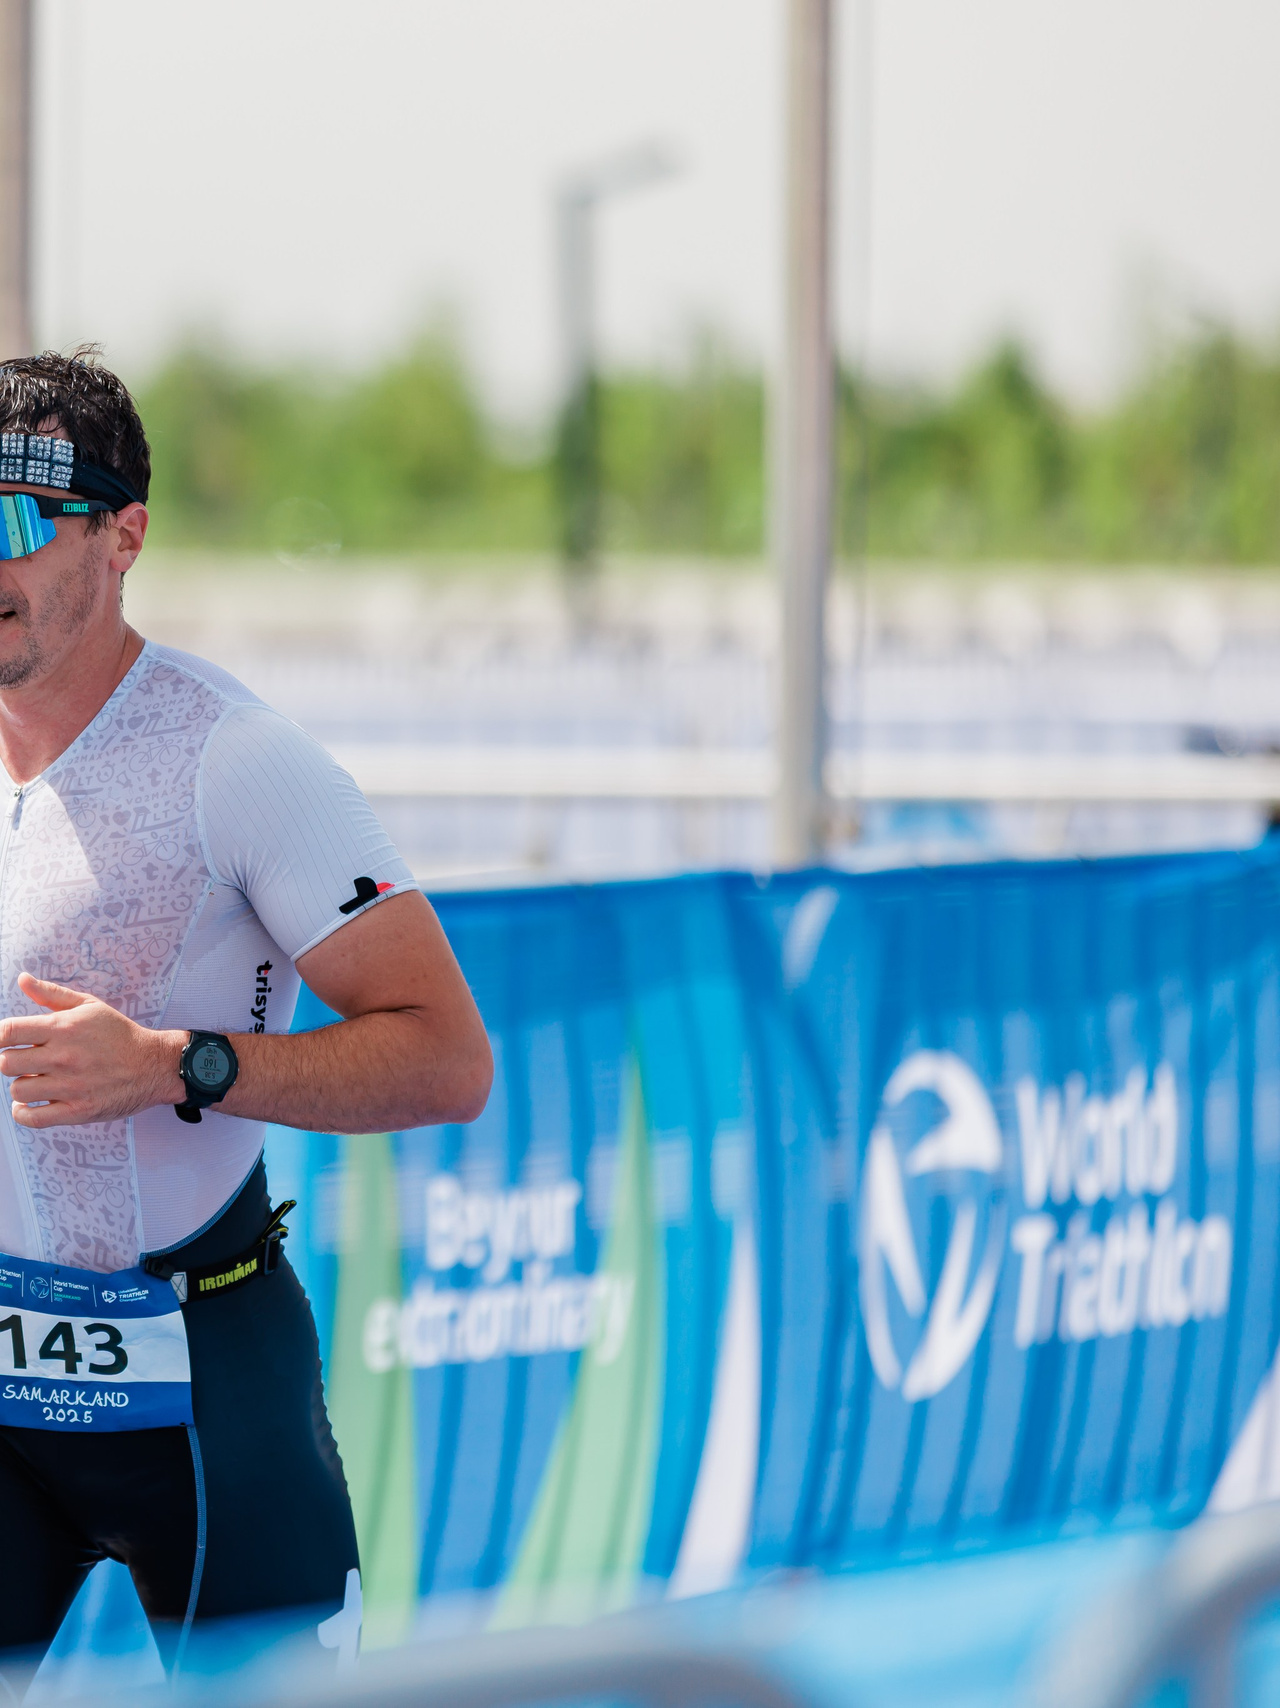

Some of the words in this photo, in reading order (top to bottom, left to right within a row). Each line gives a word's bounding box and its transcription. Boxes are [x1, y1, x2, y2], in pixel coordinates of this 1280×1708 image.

[73, 503, 89, 513] BLIZ
[144, 696, 194, 711] VO2MAX
[112, 744, 139, 755] FTP
[126, 786, 179, 805] VO2MAX
[102, 840, 130, 851] FTP
[119, 883, 177, 898] VO2MAX
[1014, 1061, 1179, 1209] World
[1, 1269, 22, 1278] Triathlon
[199, 1258, 258, 1292] IRONMAN
[1011, 1198, 1234, 1350] Triathlon
[53, 1280, 68, 1288] World
[68, 1282, 90, 1291] Triathlon
[119, 1289, 149, 1299] TRIATHLON
[2, 1384, 130, 1409] SAMARKAND
[42, 1406, 93, 1424] 2025
